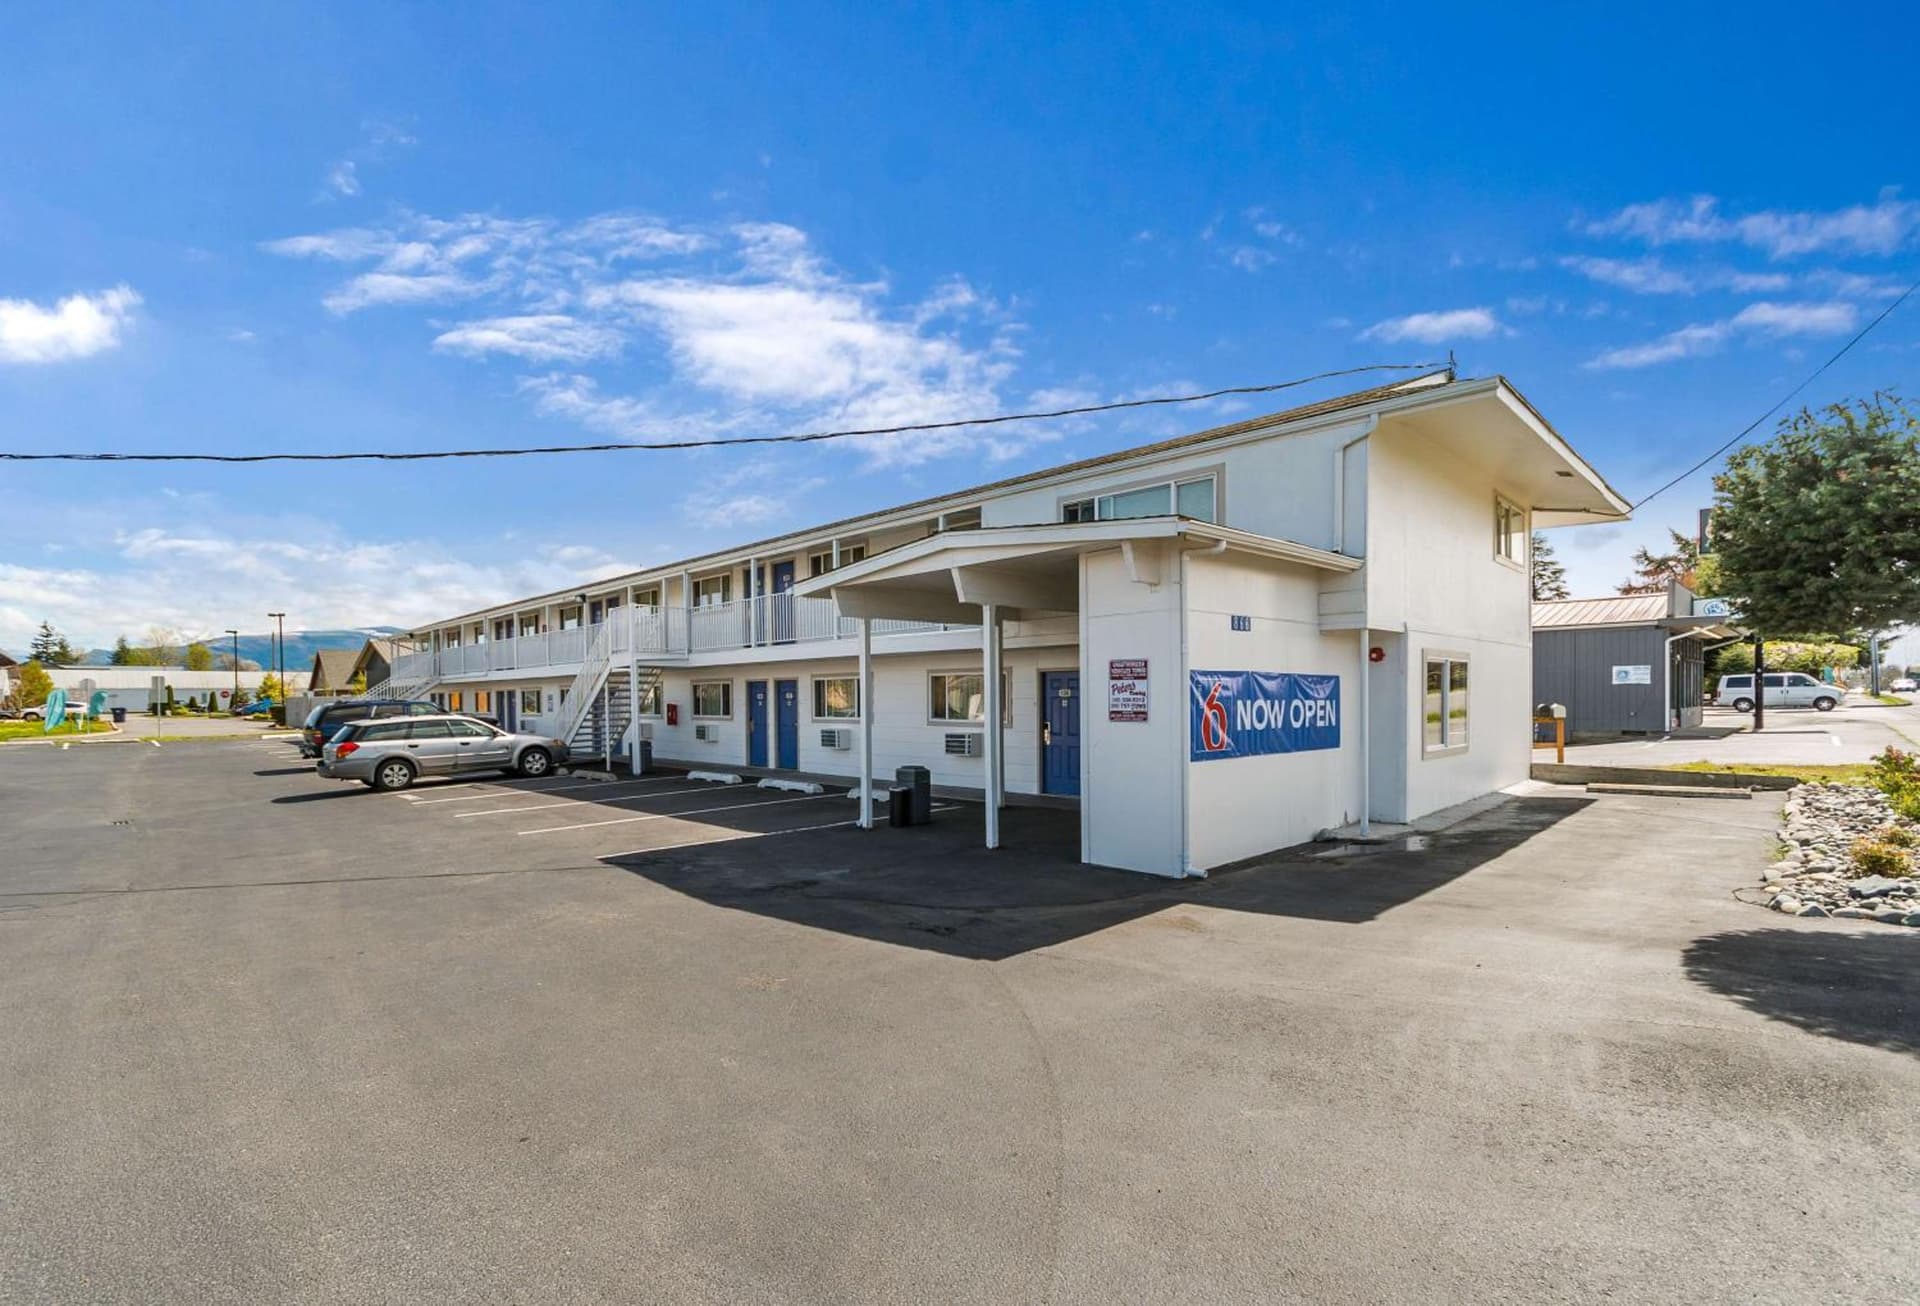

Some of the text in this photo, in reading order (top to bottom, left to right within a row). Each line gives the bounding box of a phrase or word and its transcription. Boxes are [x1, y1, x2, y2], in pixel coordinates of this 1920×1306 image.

[1202, 681, 1227, 752] 6
[1236, 698, 1336, 731] NOW OPEN
